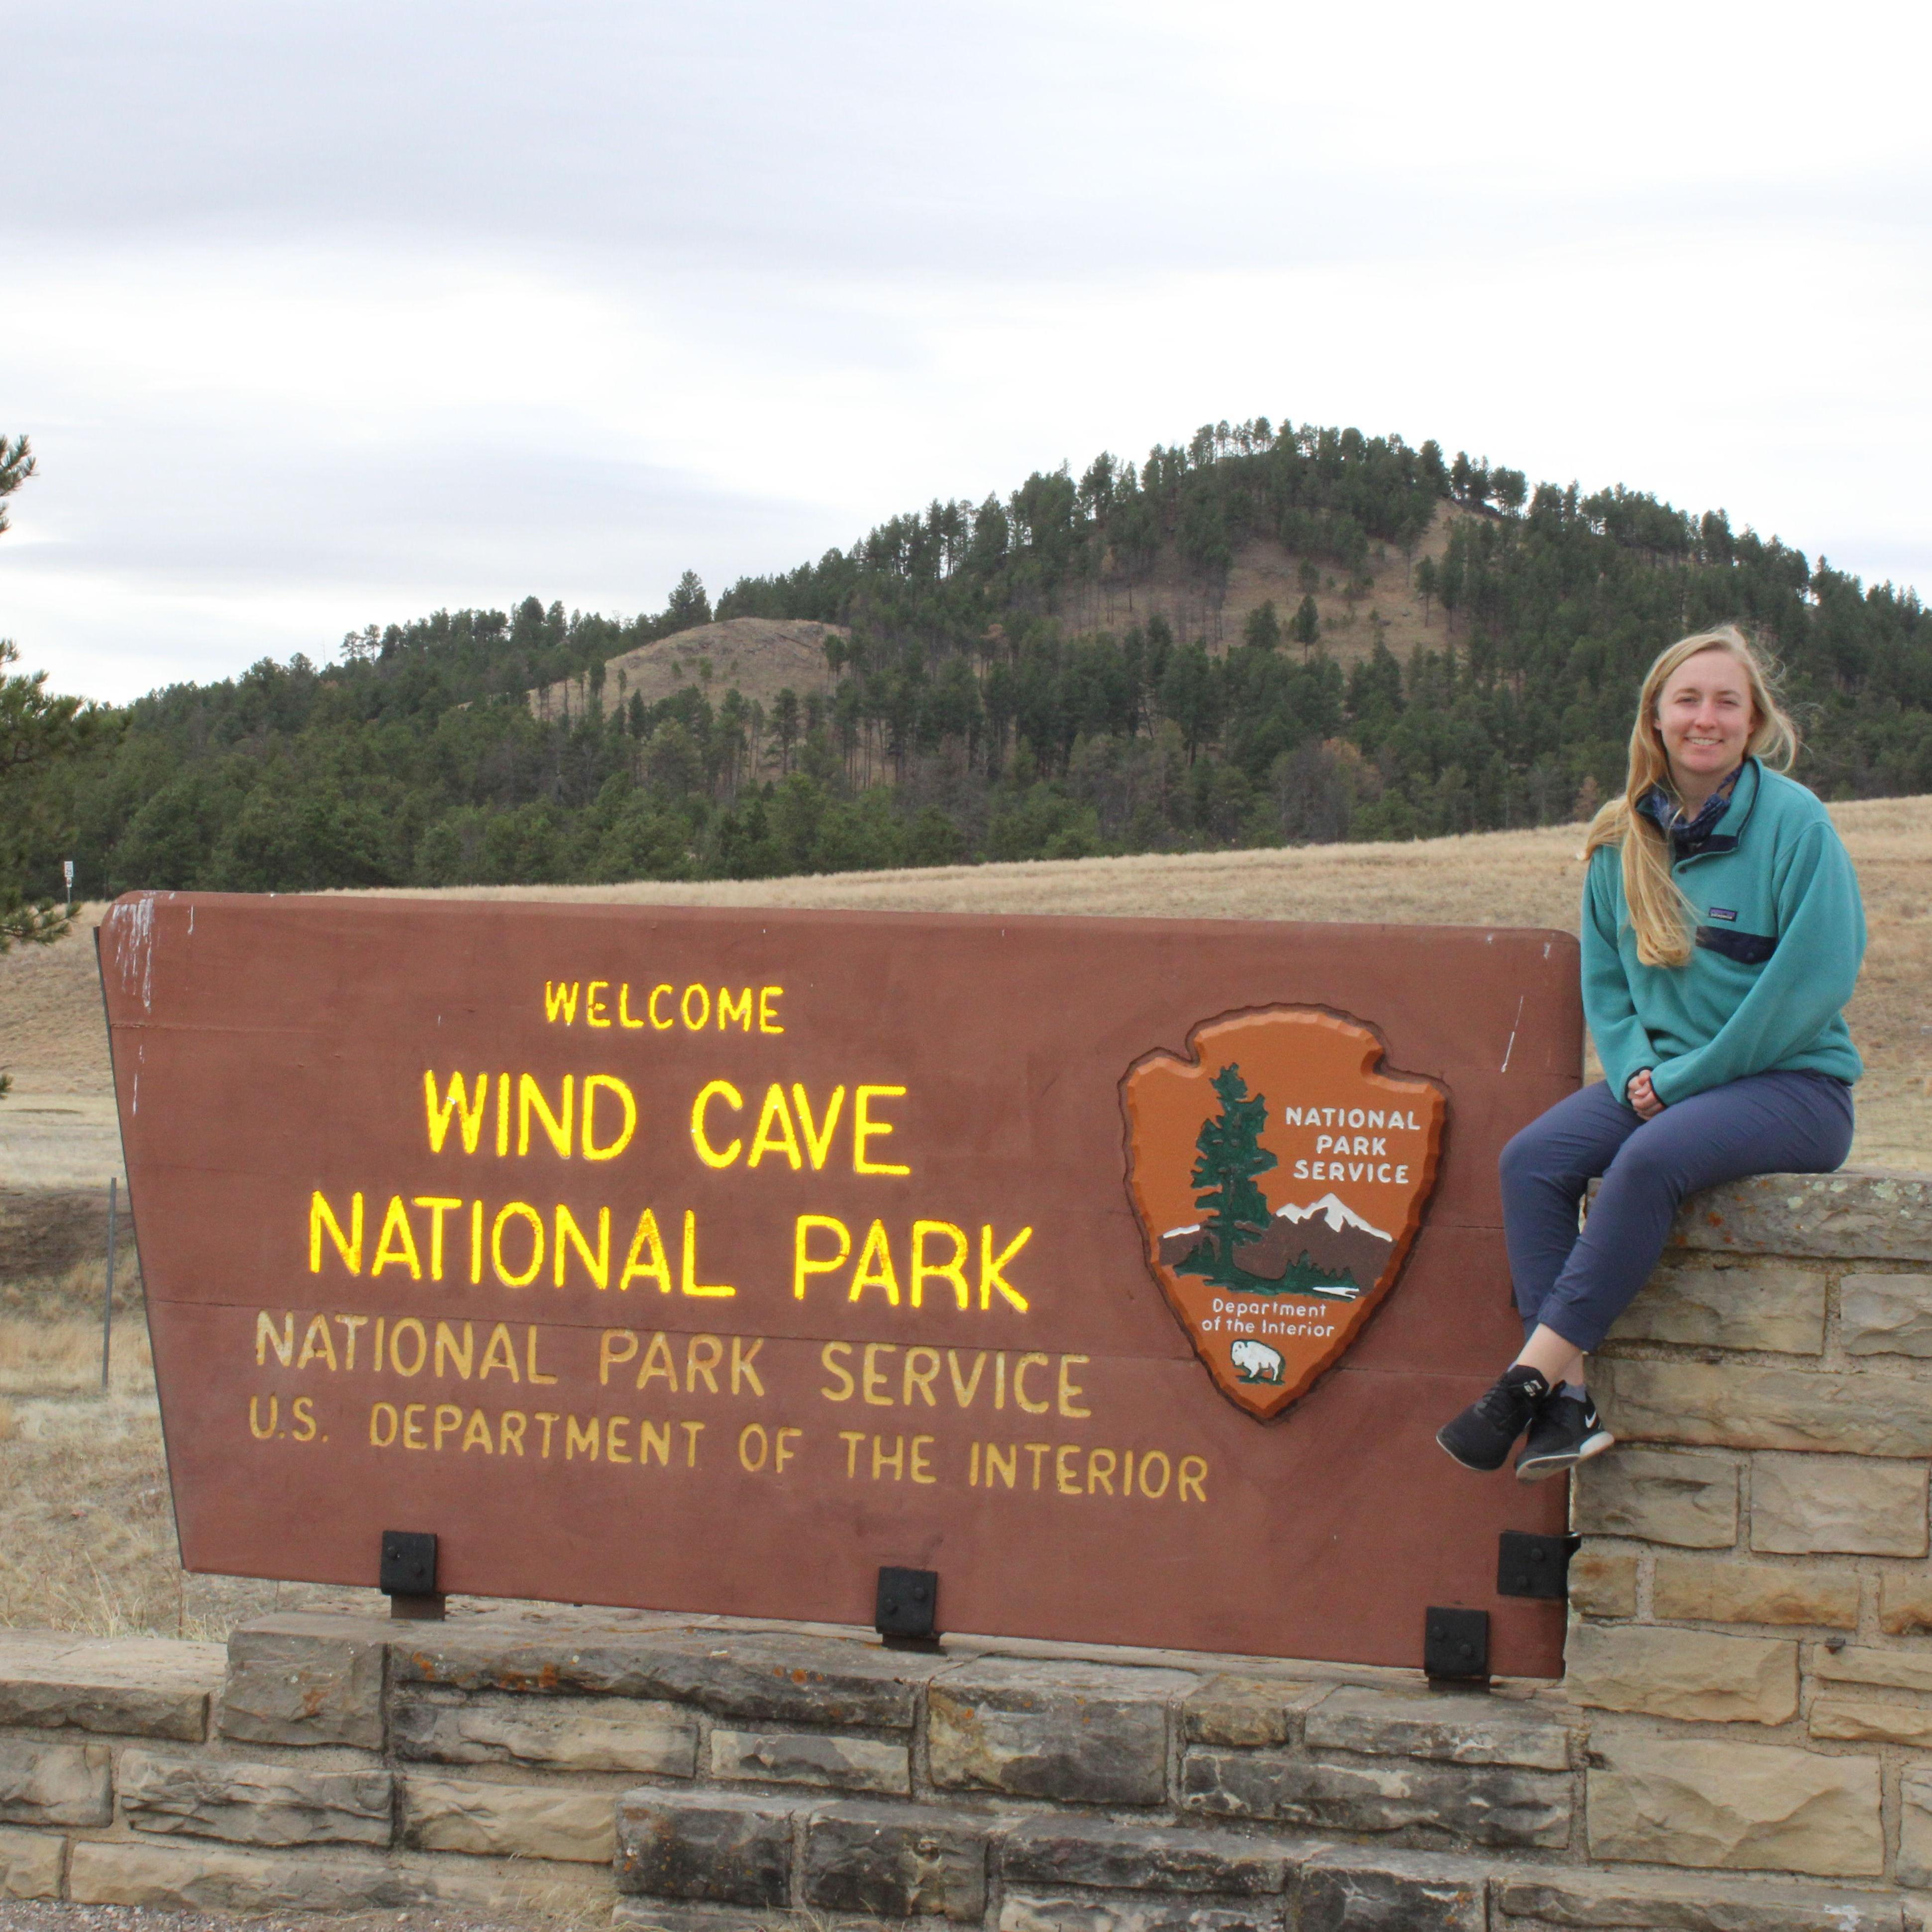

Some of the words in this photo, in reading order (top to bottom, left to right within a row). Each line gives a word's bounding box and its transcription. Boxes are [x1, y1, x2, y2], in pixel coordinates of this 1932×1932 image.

[544, 980, 785, 1035] WELCOME
[423, 1069, 638, 1162] WIND
[689, 1079, 912, 1177] CAVE
[1285, 1106, 1421, 1131] NATIONAL
[1316, 1134, 1387, 1156] PARK
[1293, 1159, 1409, 1184] SERVICE
[308, 1190, 736, 1299] NATIONAL
[793, 1214, 1033, 1314] PARK
[1201, 1318, 1221, 1332] of
[1226, 1319, 1255, 1334] the
[1262, 1320, 1335, 1337] Interior
[1212, 1297, 1326, 1318] Department
[255, 1310, 558, 1384] NATIONAL
[600, 1328, 765, 1397] PARK
[820, 1342, 1092, 1418] SERVICE
[249, 1395, 329, 1442] U.S.
[369, 1402, 706, 1467] DEPARTMENT
[739, 1423, 803, 1473] OF
[839, 1431, 937, 1484] THE
[969, 1440, 1208, 1503] INTERIOR
